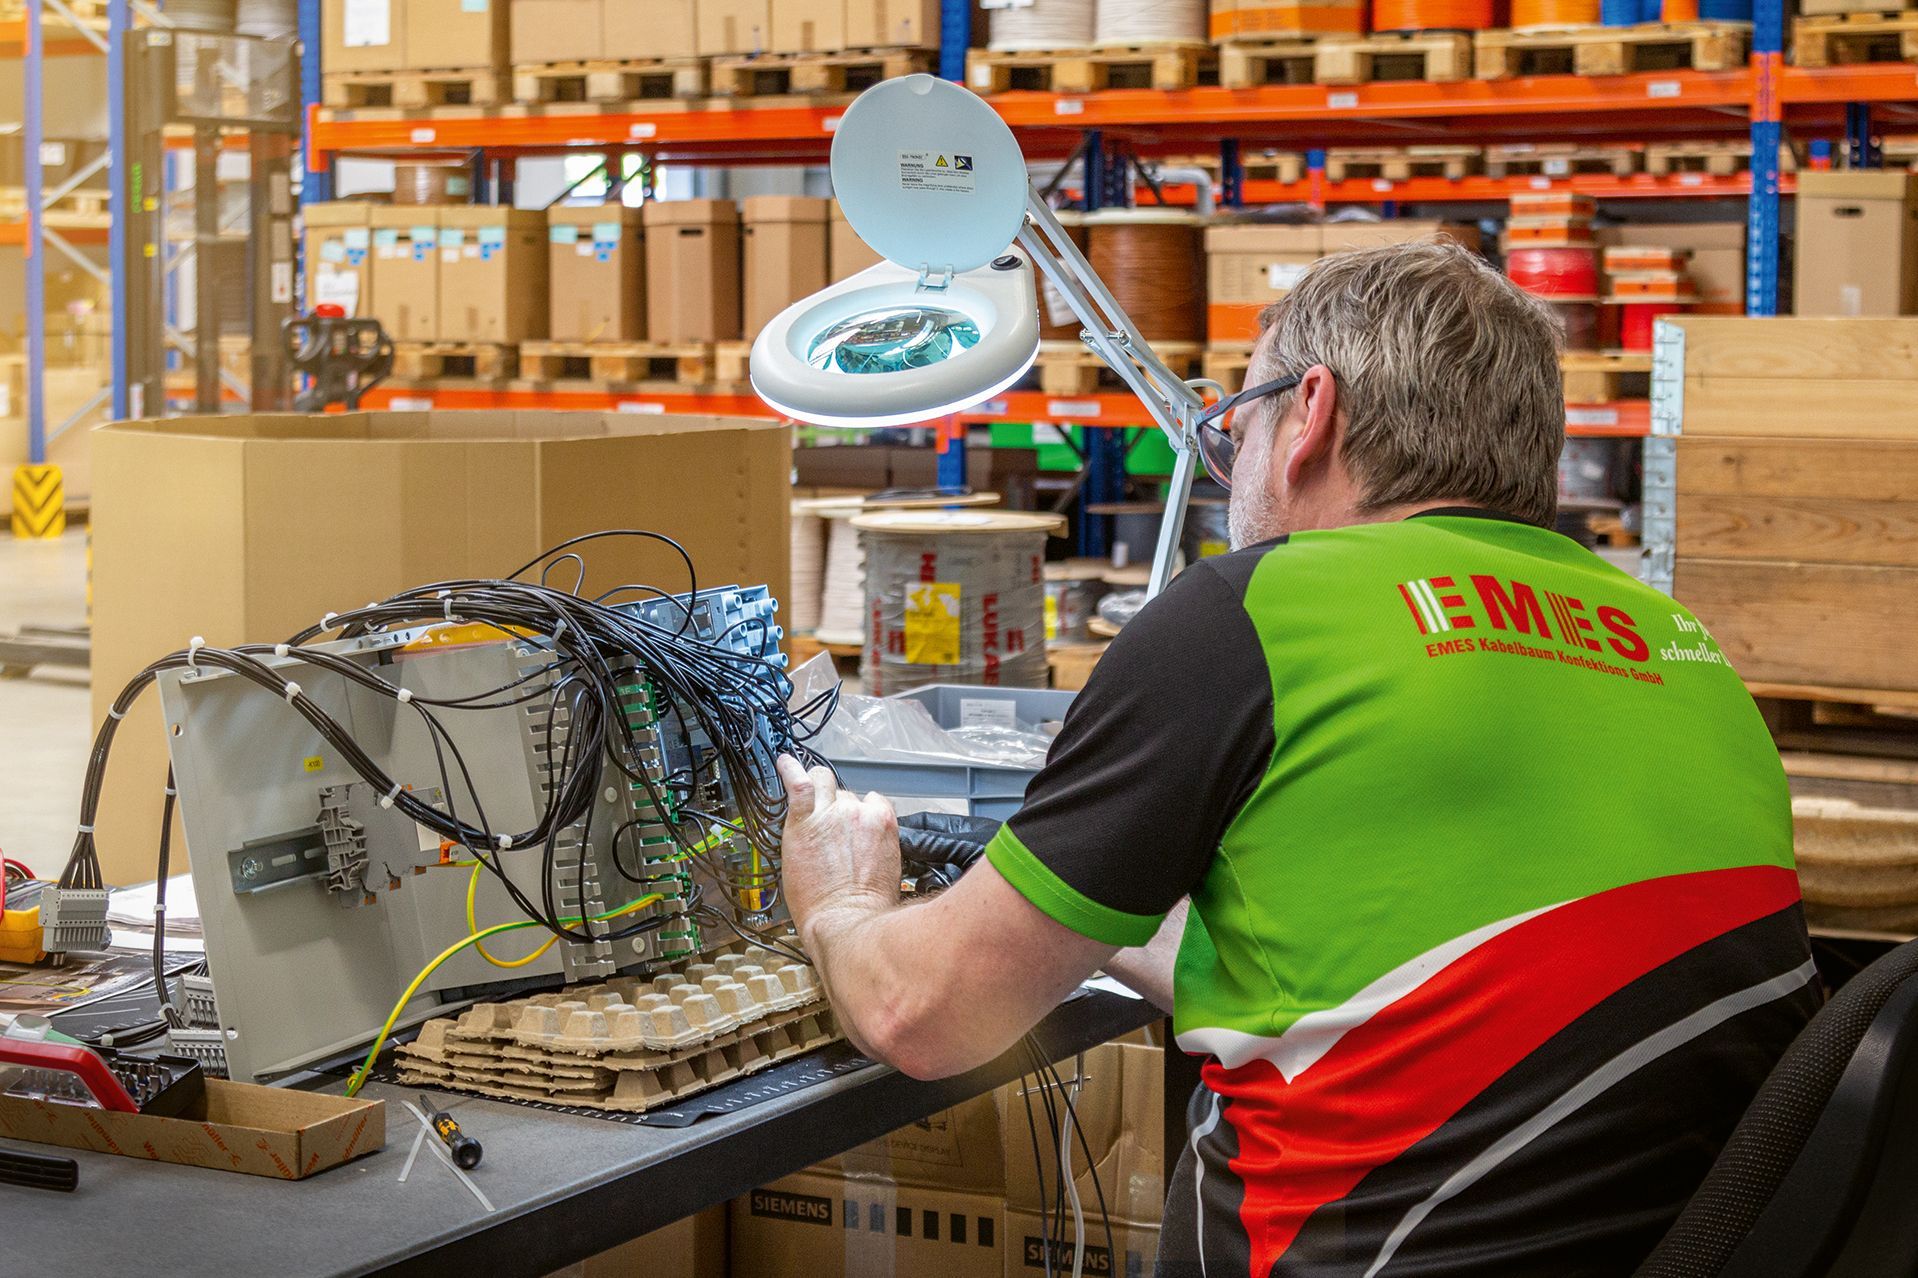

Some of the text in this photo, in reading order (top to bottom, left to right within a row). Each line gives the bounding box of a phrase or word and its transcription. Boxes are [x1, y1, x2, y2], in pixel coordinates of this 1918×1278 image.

[1397, 574, 1650, 663] EMES
[1671, 613, 1697, 632] Ihr
[1425, 637, 1665, 687] EMES Kabelbaum Konfektions GmbH
[1660, 640, 1722, 665] schneller
[754, 1195, 829, 1220] SIEMENS
